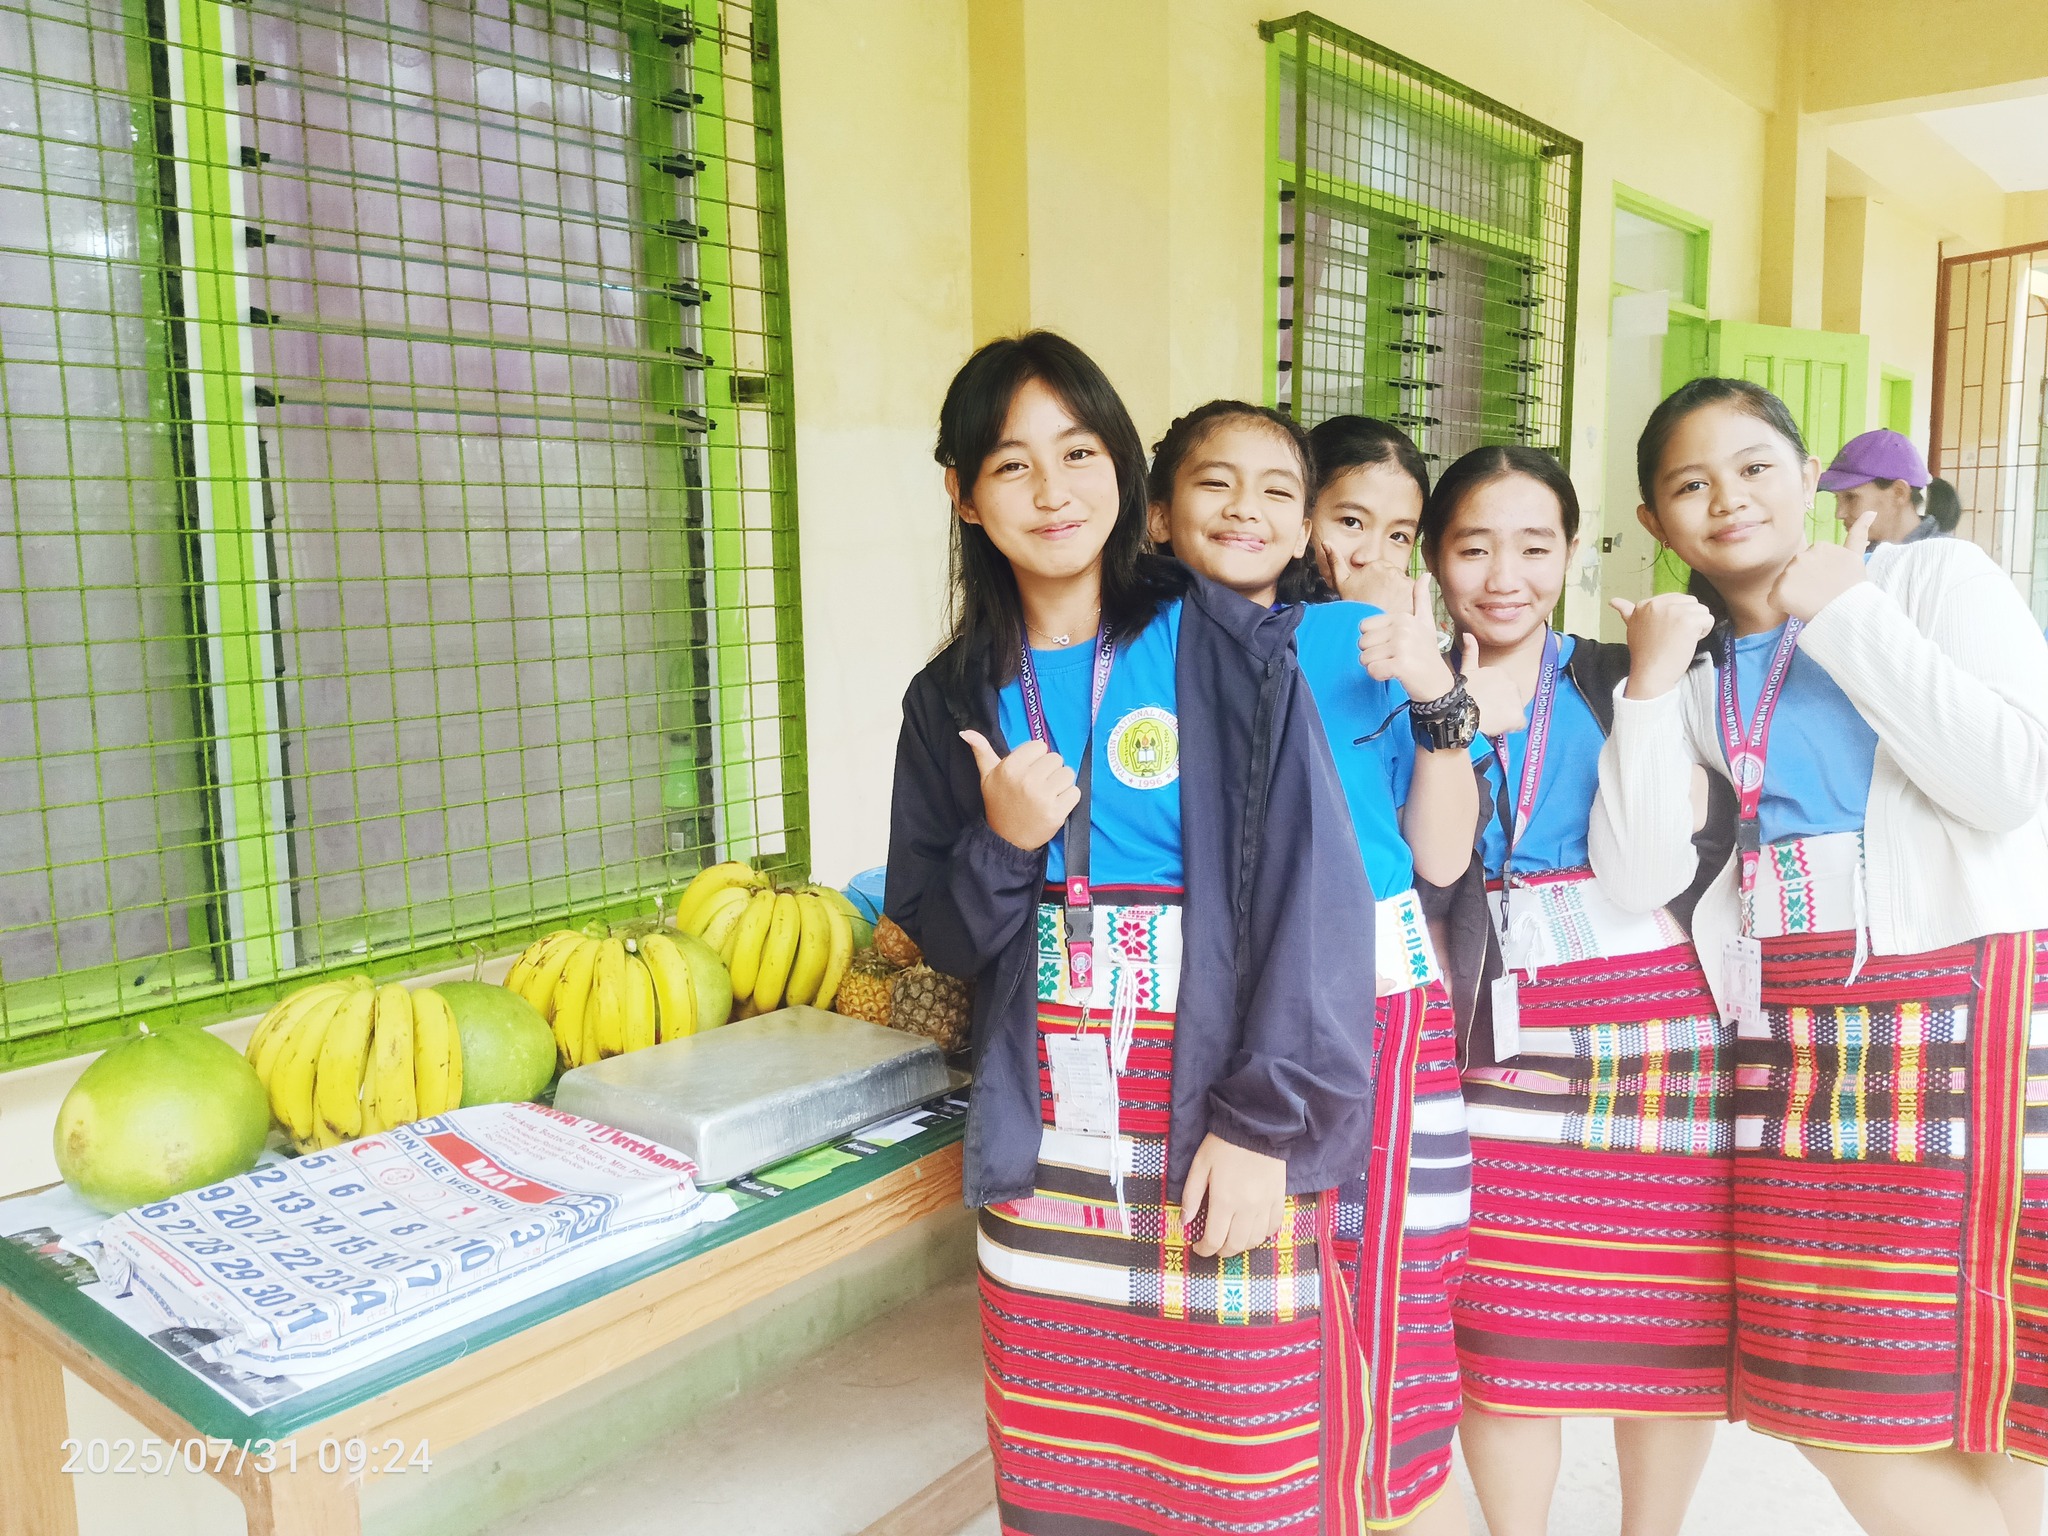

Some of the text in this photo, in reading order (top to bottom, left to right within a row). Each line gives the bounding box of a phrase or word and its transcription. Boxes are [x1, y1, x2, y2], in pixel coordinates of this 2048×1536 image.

[1026, 686, 1039, 716] HIGH
[1722, 668, 1734, 708] NATIONAL
[1751, 704, 1769, 747] TALUBIN
[1764, 657, 1787, 703] NATIONAL
[1782, 633, 1795, 657] HIGH
[1114, 708, 1156, 737] NATIONAL
[1157, 711, 1179, 730] HIGH
[1522, 663, 1555, 806] TALUBIN NATIONAL HIGH SCHOOL
[1725, 708, 1741, 748] TALUBIN
[1108, 738, 1125, 779] TALUBIN
[1137, 778, 1163, 788] 1996
[462, 1158, 528, 1190] MAY
[300, 1154, 337, 1169] 5
[328, 1183, 365, 1197] 6
[358, 1201, 398, 1216] 7
[390, 1223, 429, 1236] 8
[450, 1238, 496, 1273] 10
[416, 1152, 449, 1176] TUE
[446, 1177, 481, 1195] WED
[480, 1195, 514, 1210] THU
[549, 1210, 571, 1239] SAT
[270, 1190, 316, 1214] 13
[300, 1215, 347, 1235] 14
[330, 1235, 379, 1255] 15
[363, 1252, 410, 1270] 16
[396, 1258, 442, 1289] 17
[510, 1223, 546, 1248] 3
[156, 1219, 207, 1236] 27
[183, 1237, 235, 1255] 28
[210, 1258, 265, 1280] 29
[241, 1284, 297, 1307] 30
[273, 1302, 329, 1334] 31
[212, 1204, 263, 1229] 20
[241, 1229, 292, 1244] 21
[270, 1247, 324, 1271] 22
[301, 1268, 356, 1289] 23
[335, 1279, 387, 1316] 24
